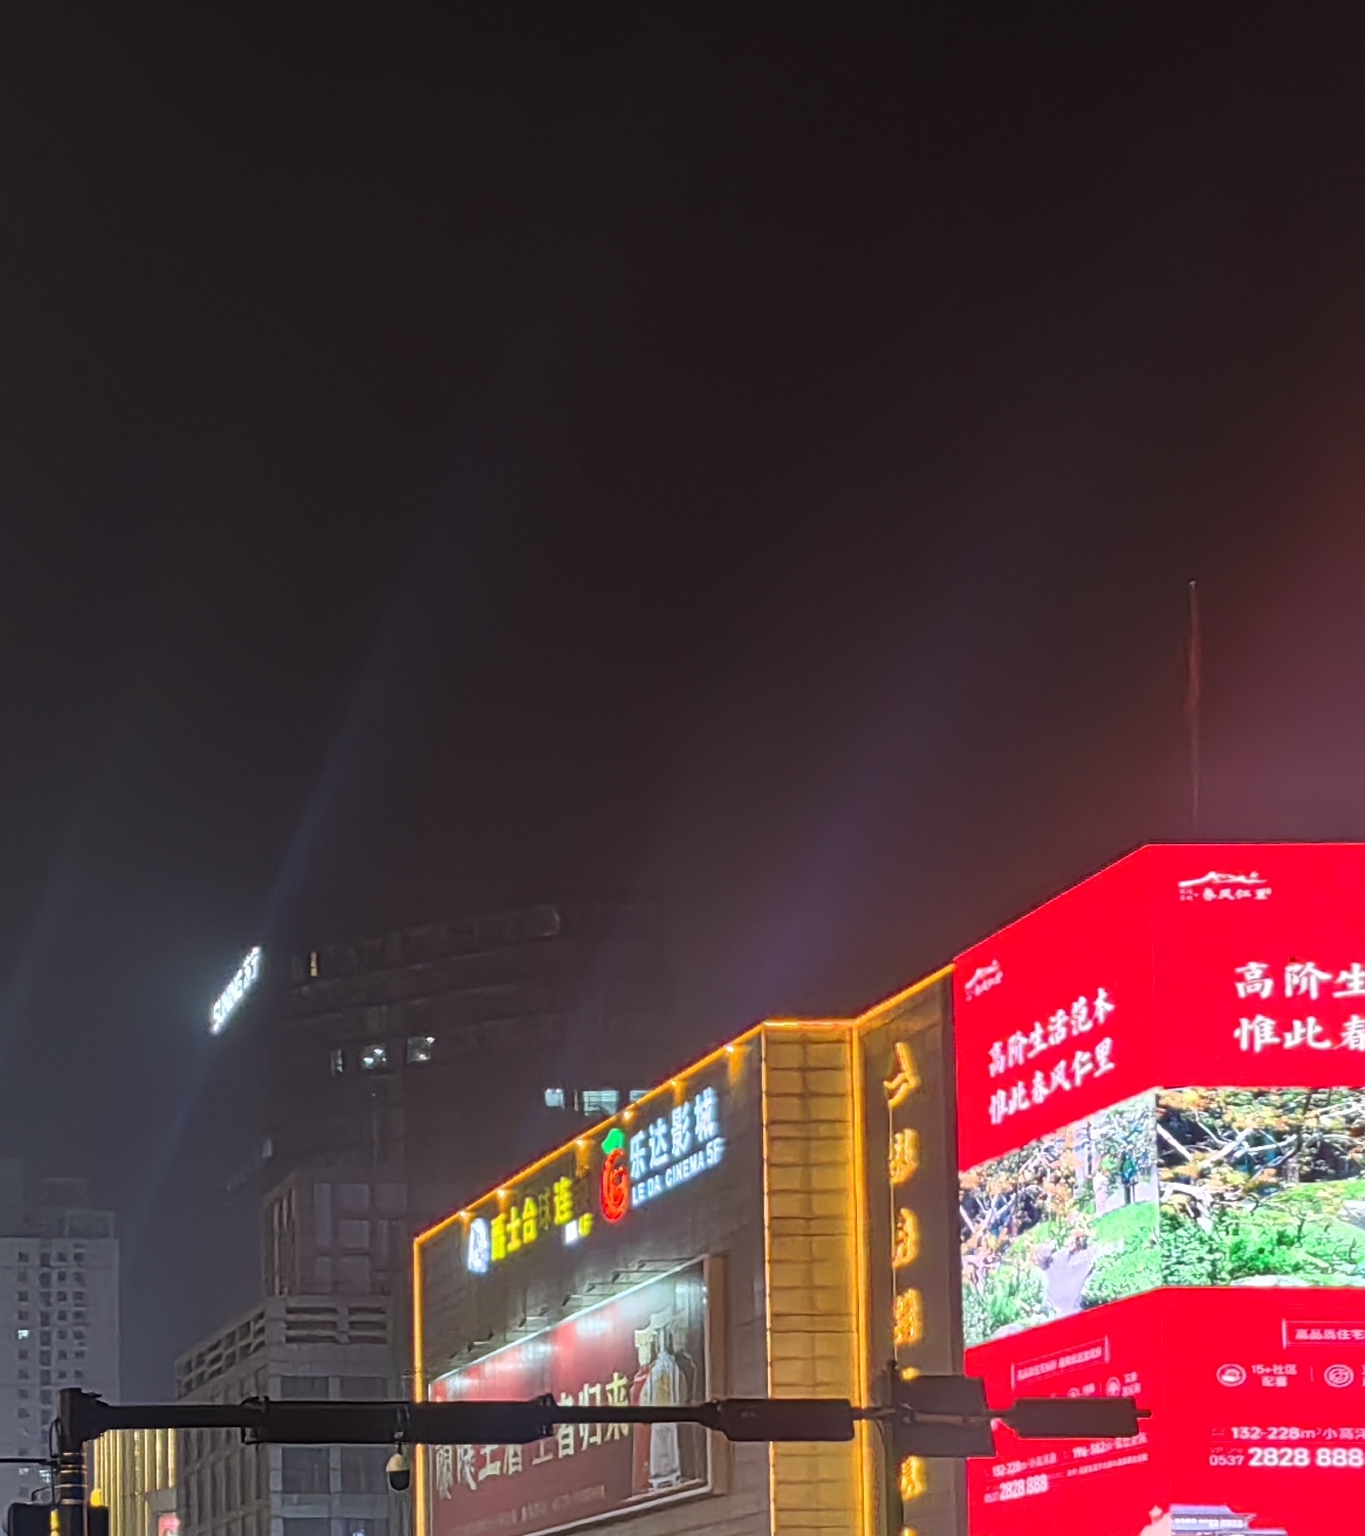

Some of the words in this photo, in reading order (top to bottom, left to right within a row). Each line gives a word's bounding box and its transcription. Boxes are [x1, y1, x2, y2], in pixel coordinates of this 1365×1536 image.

[989, 987, 1115, 1078] 高阶生活范本
[989, 1037, 1115, 1125] 惟此春风仁里
[630, 1086, 720, 1179] 乐达影城
[665, 1151, 704, 1187] CINEMA
[999, 1479, 1026, 1501] 2828
[1026, 1474, 1049, 1495] 888
[1209, 1455, 1244, 1466] 0537
[1248, 1447, 1310, 1467] 2828
[1316, 1447, 1365, 1467] 888
